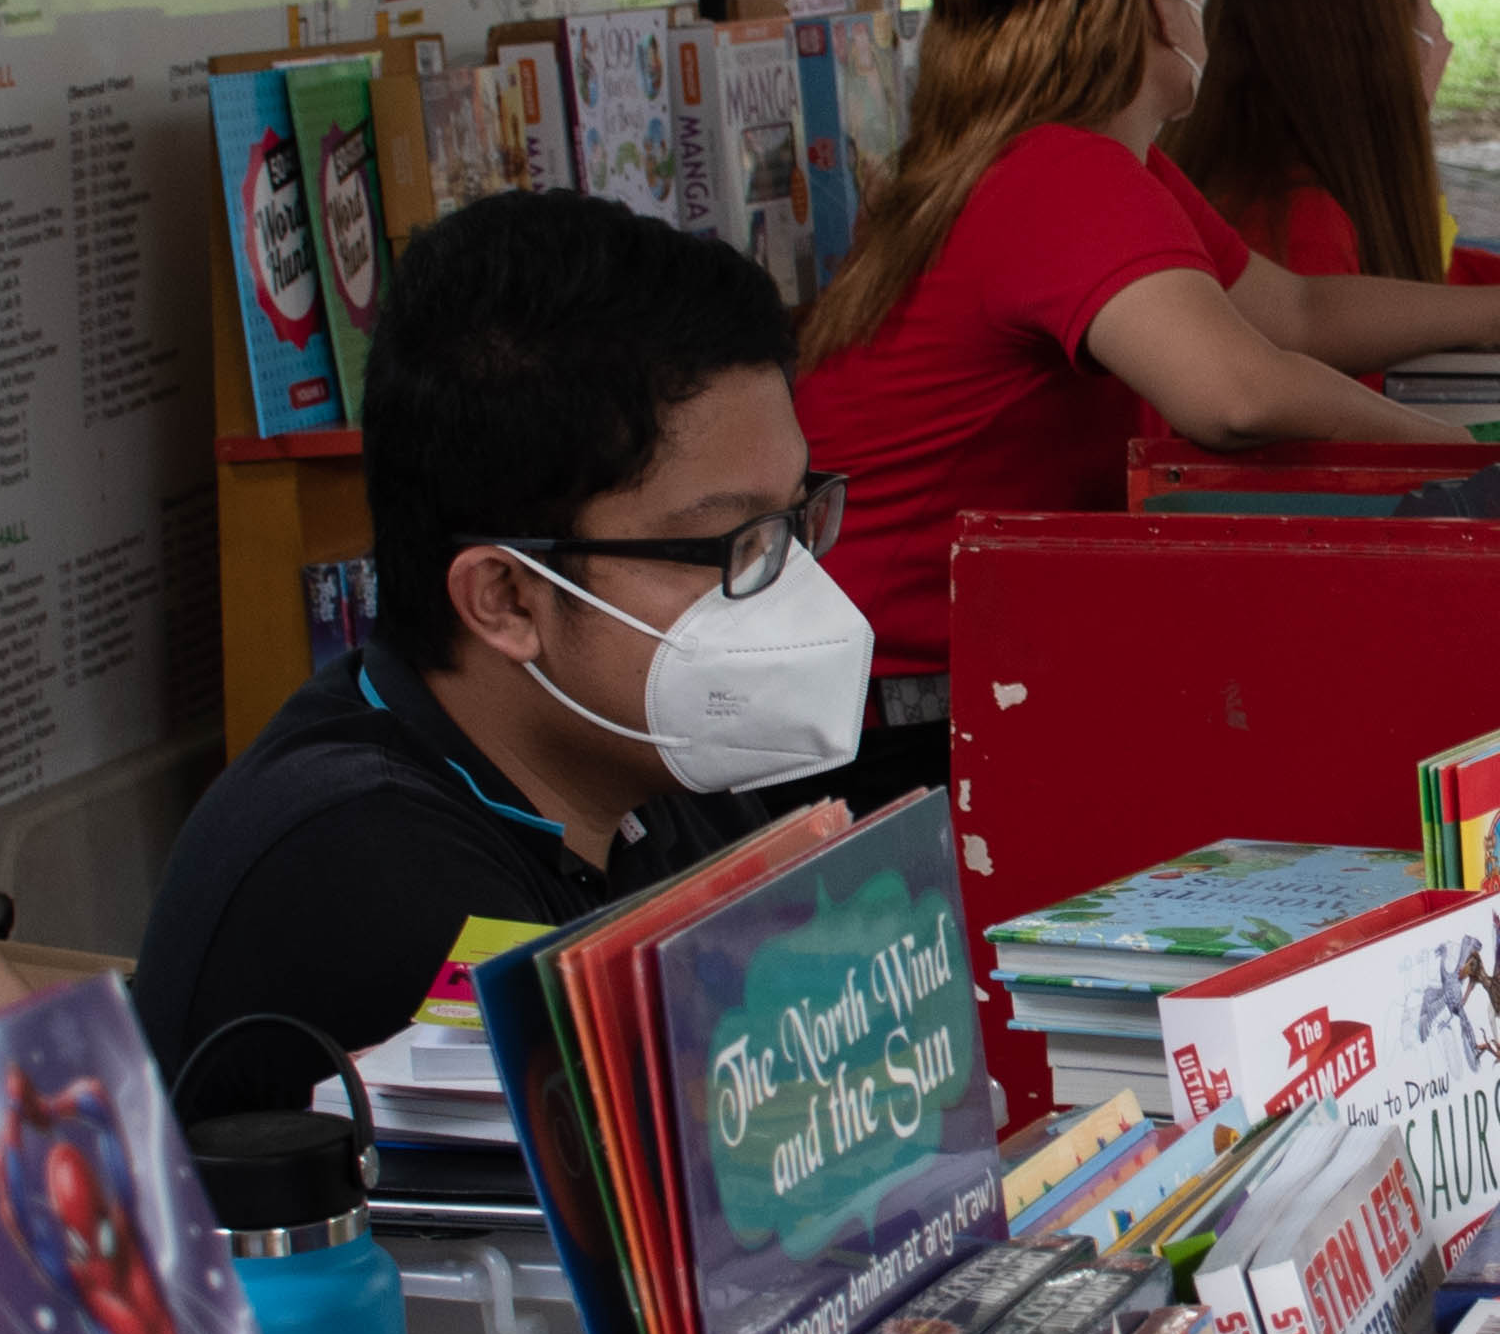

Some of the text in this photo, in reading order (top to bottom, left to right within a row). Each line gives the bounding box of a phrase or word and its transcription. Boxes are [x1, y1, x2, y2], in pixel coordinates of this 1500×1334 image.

[677, 116, 708, 220] MANGA
[713, 912, 954, 1147] The North Wind
[1294, 1018, 1322, 1052] The
[773, 1026, 957, 1195] and the Sun
[1347, 1071, 1450, 1127] How to Draw
[847, 1256, 903, 1329] Amihan
[902, 1233, 924, 1271] at
[924, 1207, 960, 1264] ang
[952, 1165, 998, 1231] Araw)
